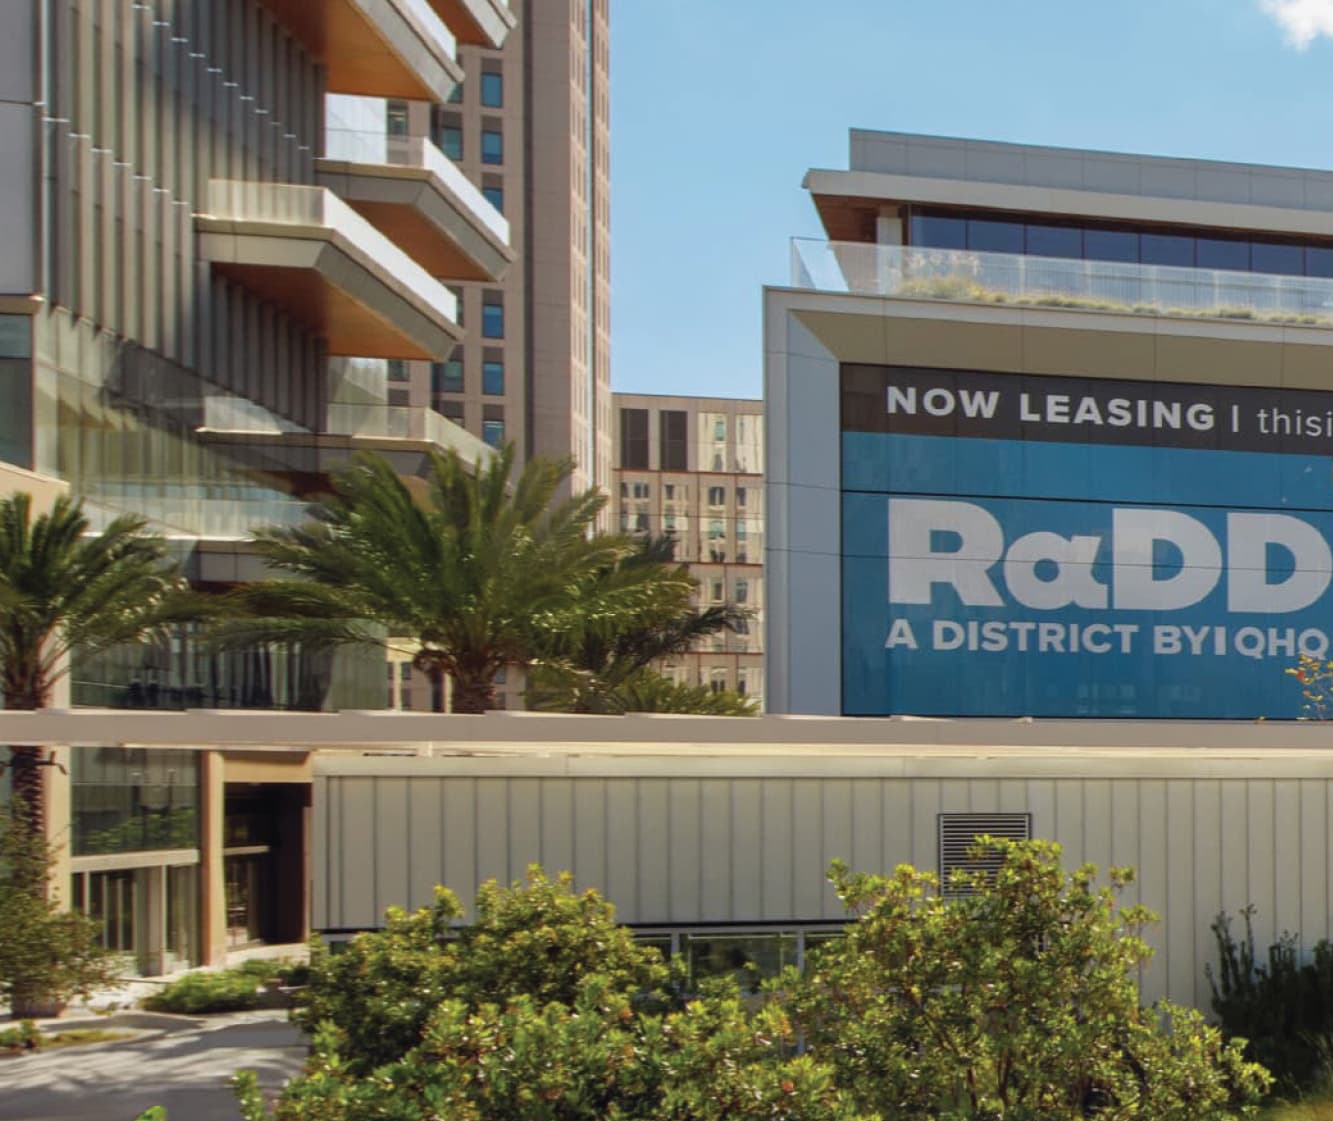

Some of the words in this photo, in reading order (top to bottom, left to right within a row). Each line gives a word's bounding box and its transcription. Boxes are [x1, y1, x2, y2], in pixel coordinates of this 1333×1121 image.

[887, 386, 999, 418] NOW
[1019, 393, 1215, 431] LEASING
[887, 497, 1333, 614] RaDD
[884, 619, 918, 650] A
[932, 620, 1140, 653] DISTRICT
